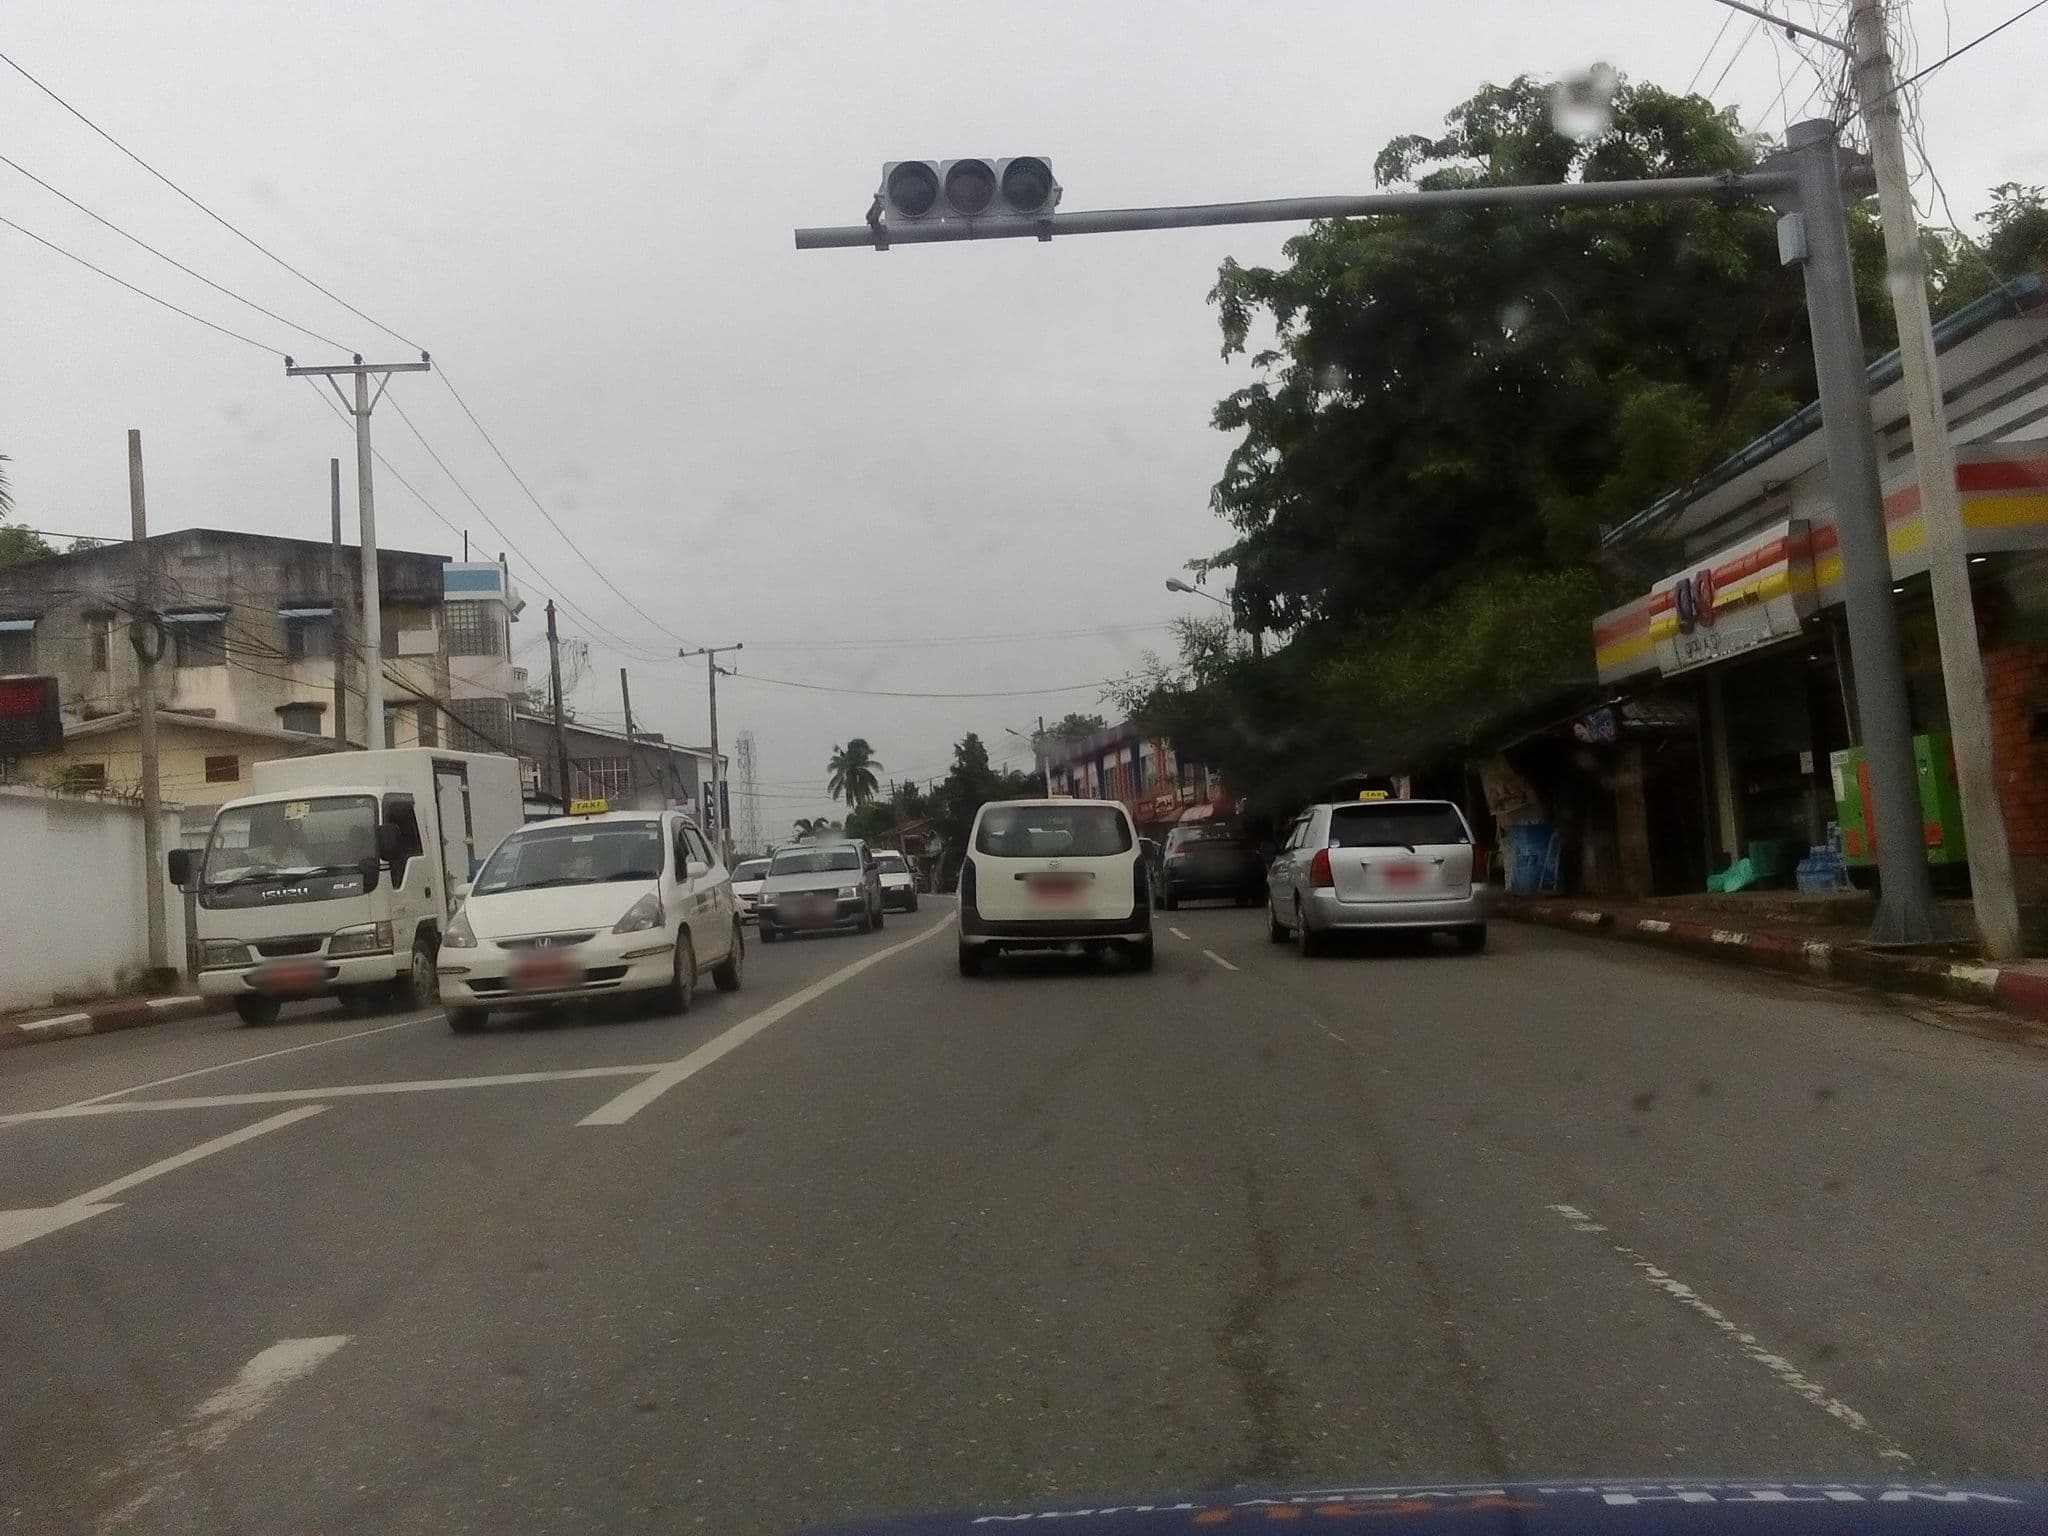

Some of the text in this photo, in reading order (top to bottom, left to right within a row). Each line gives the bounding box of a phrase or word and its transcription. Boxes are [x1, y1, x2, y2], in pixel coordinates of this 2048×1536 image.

[576, 801, 601, 809] TAXI
[333, 882, 359, 890] ELF
[262, 887, 309, 900] ISUZU
